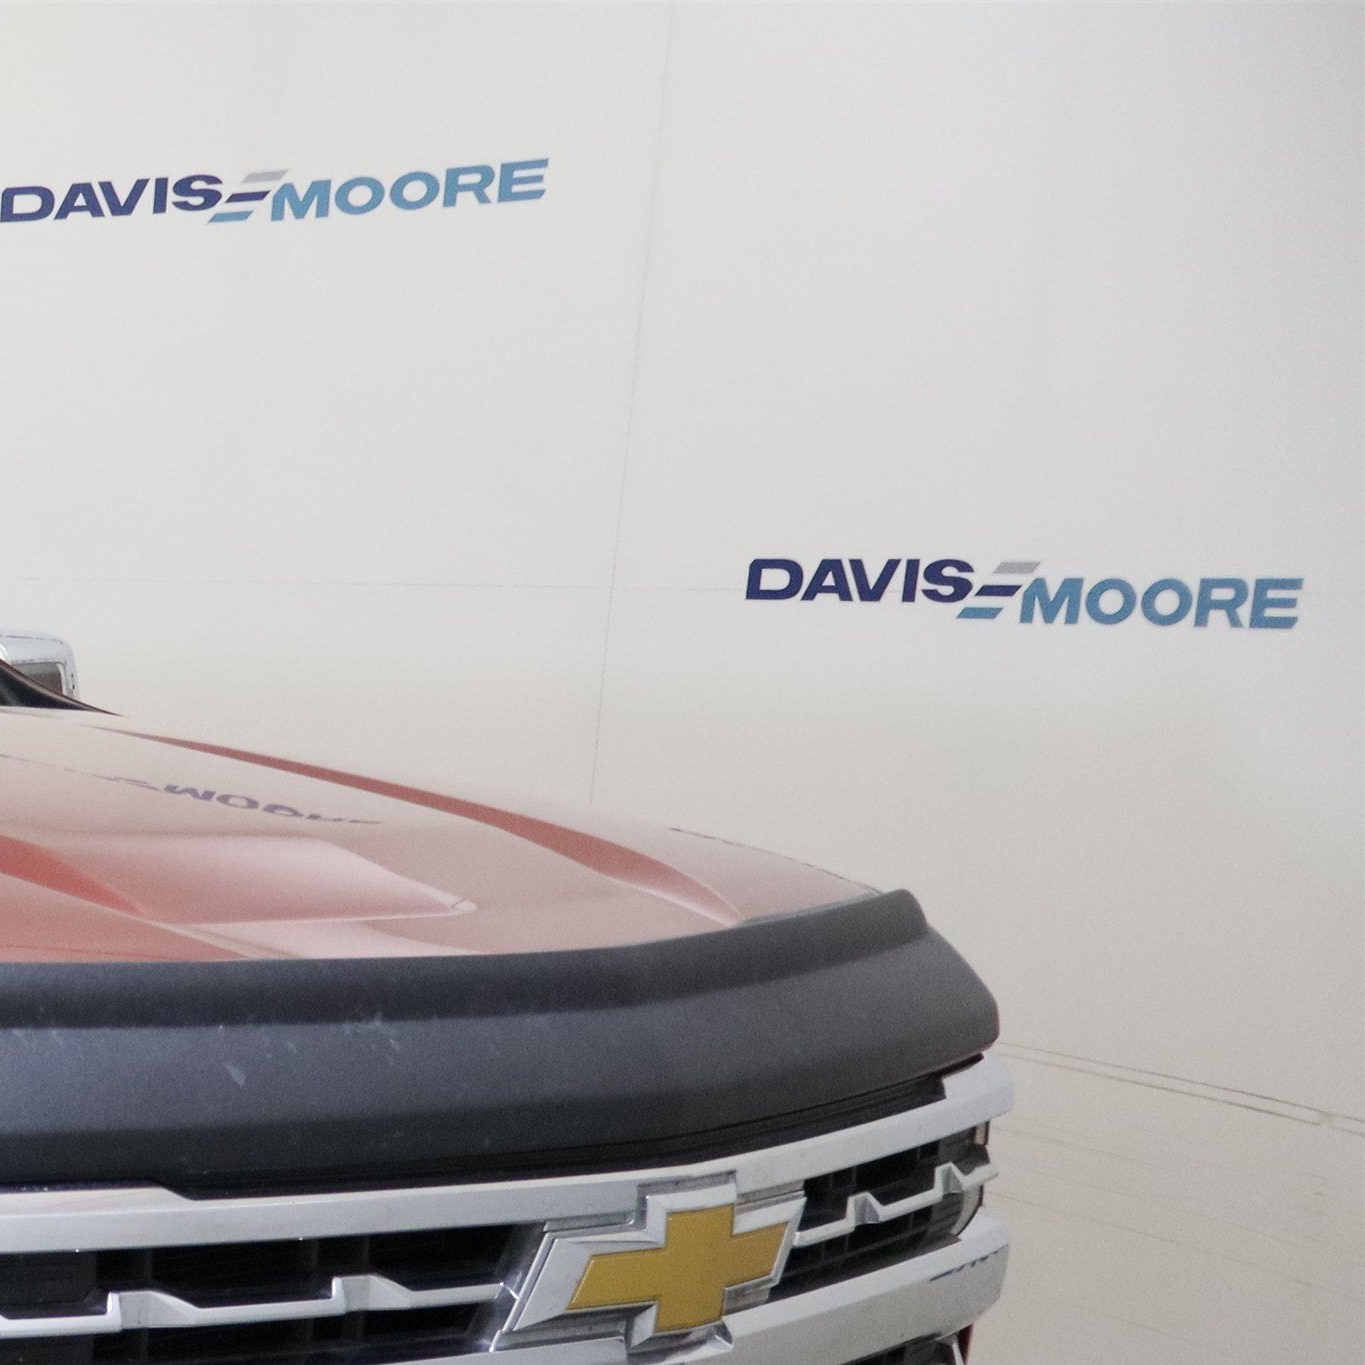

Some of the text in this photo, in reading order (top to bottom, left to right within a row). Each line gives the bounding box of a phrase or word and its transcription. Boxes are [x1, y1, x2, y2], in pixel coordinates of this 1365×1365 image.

[0, 157, 550, 223] DAVIS MOORE
[745, 557, 1305, 630] DAVIS MOORE
